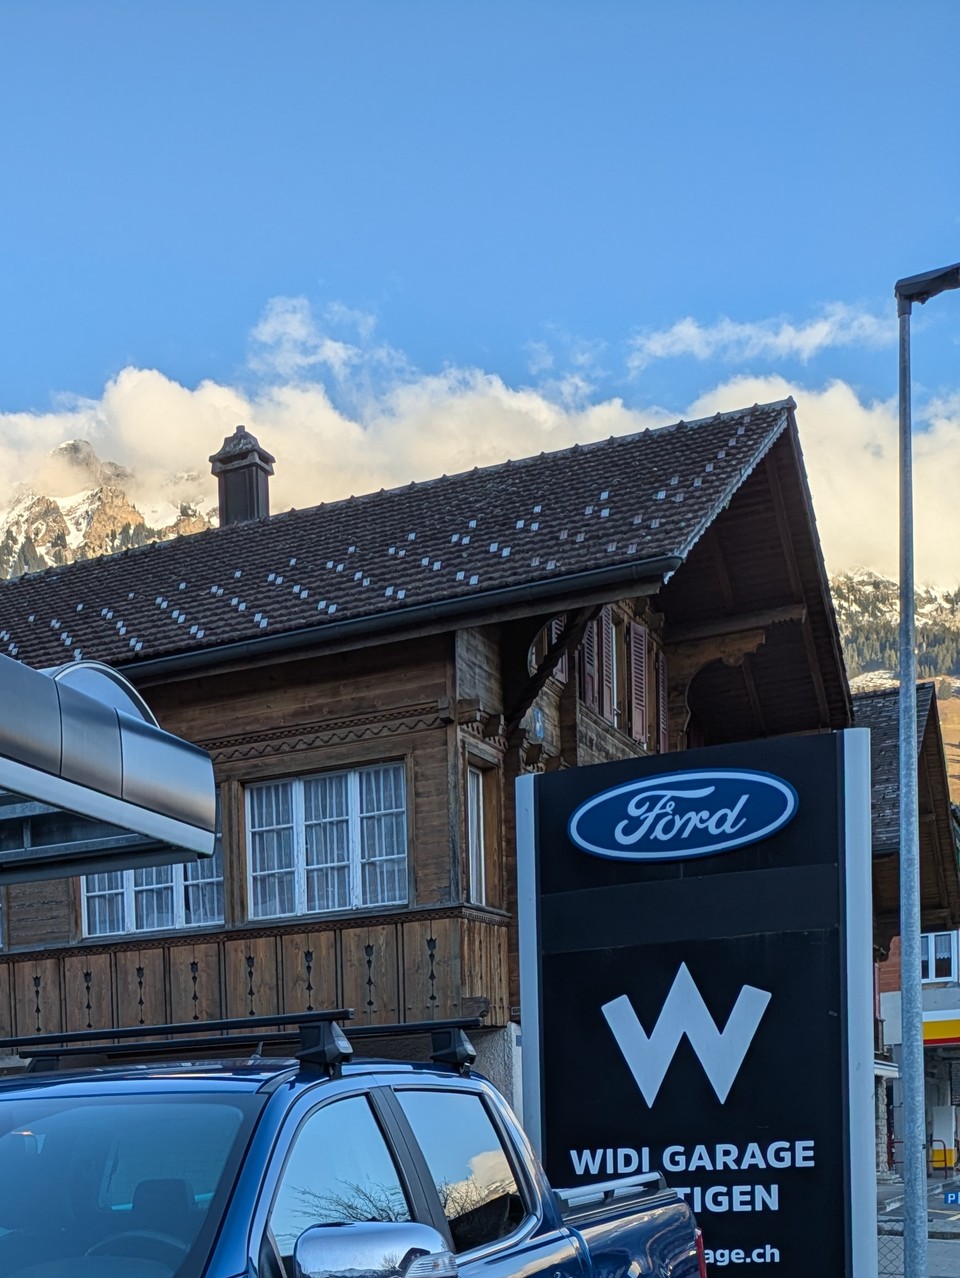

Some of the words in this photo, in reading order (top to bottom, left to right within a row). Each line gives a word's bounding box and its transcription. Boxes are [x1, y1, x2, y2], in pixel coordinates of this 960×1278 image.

[614, 785, 750, 846] Ford
[601, 961, 772, 1109] W
[569, 1147, 650, 1175] WIDI
[662, 1140, 816, 1172] GARAGE
[671, 1184, 780, 1213] TIGEN
[704, 1244, 781, 1267] age.ch
